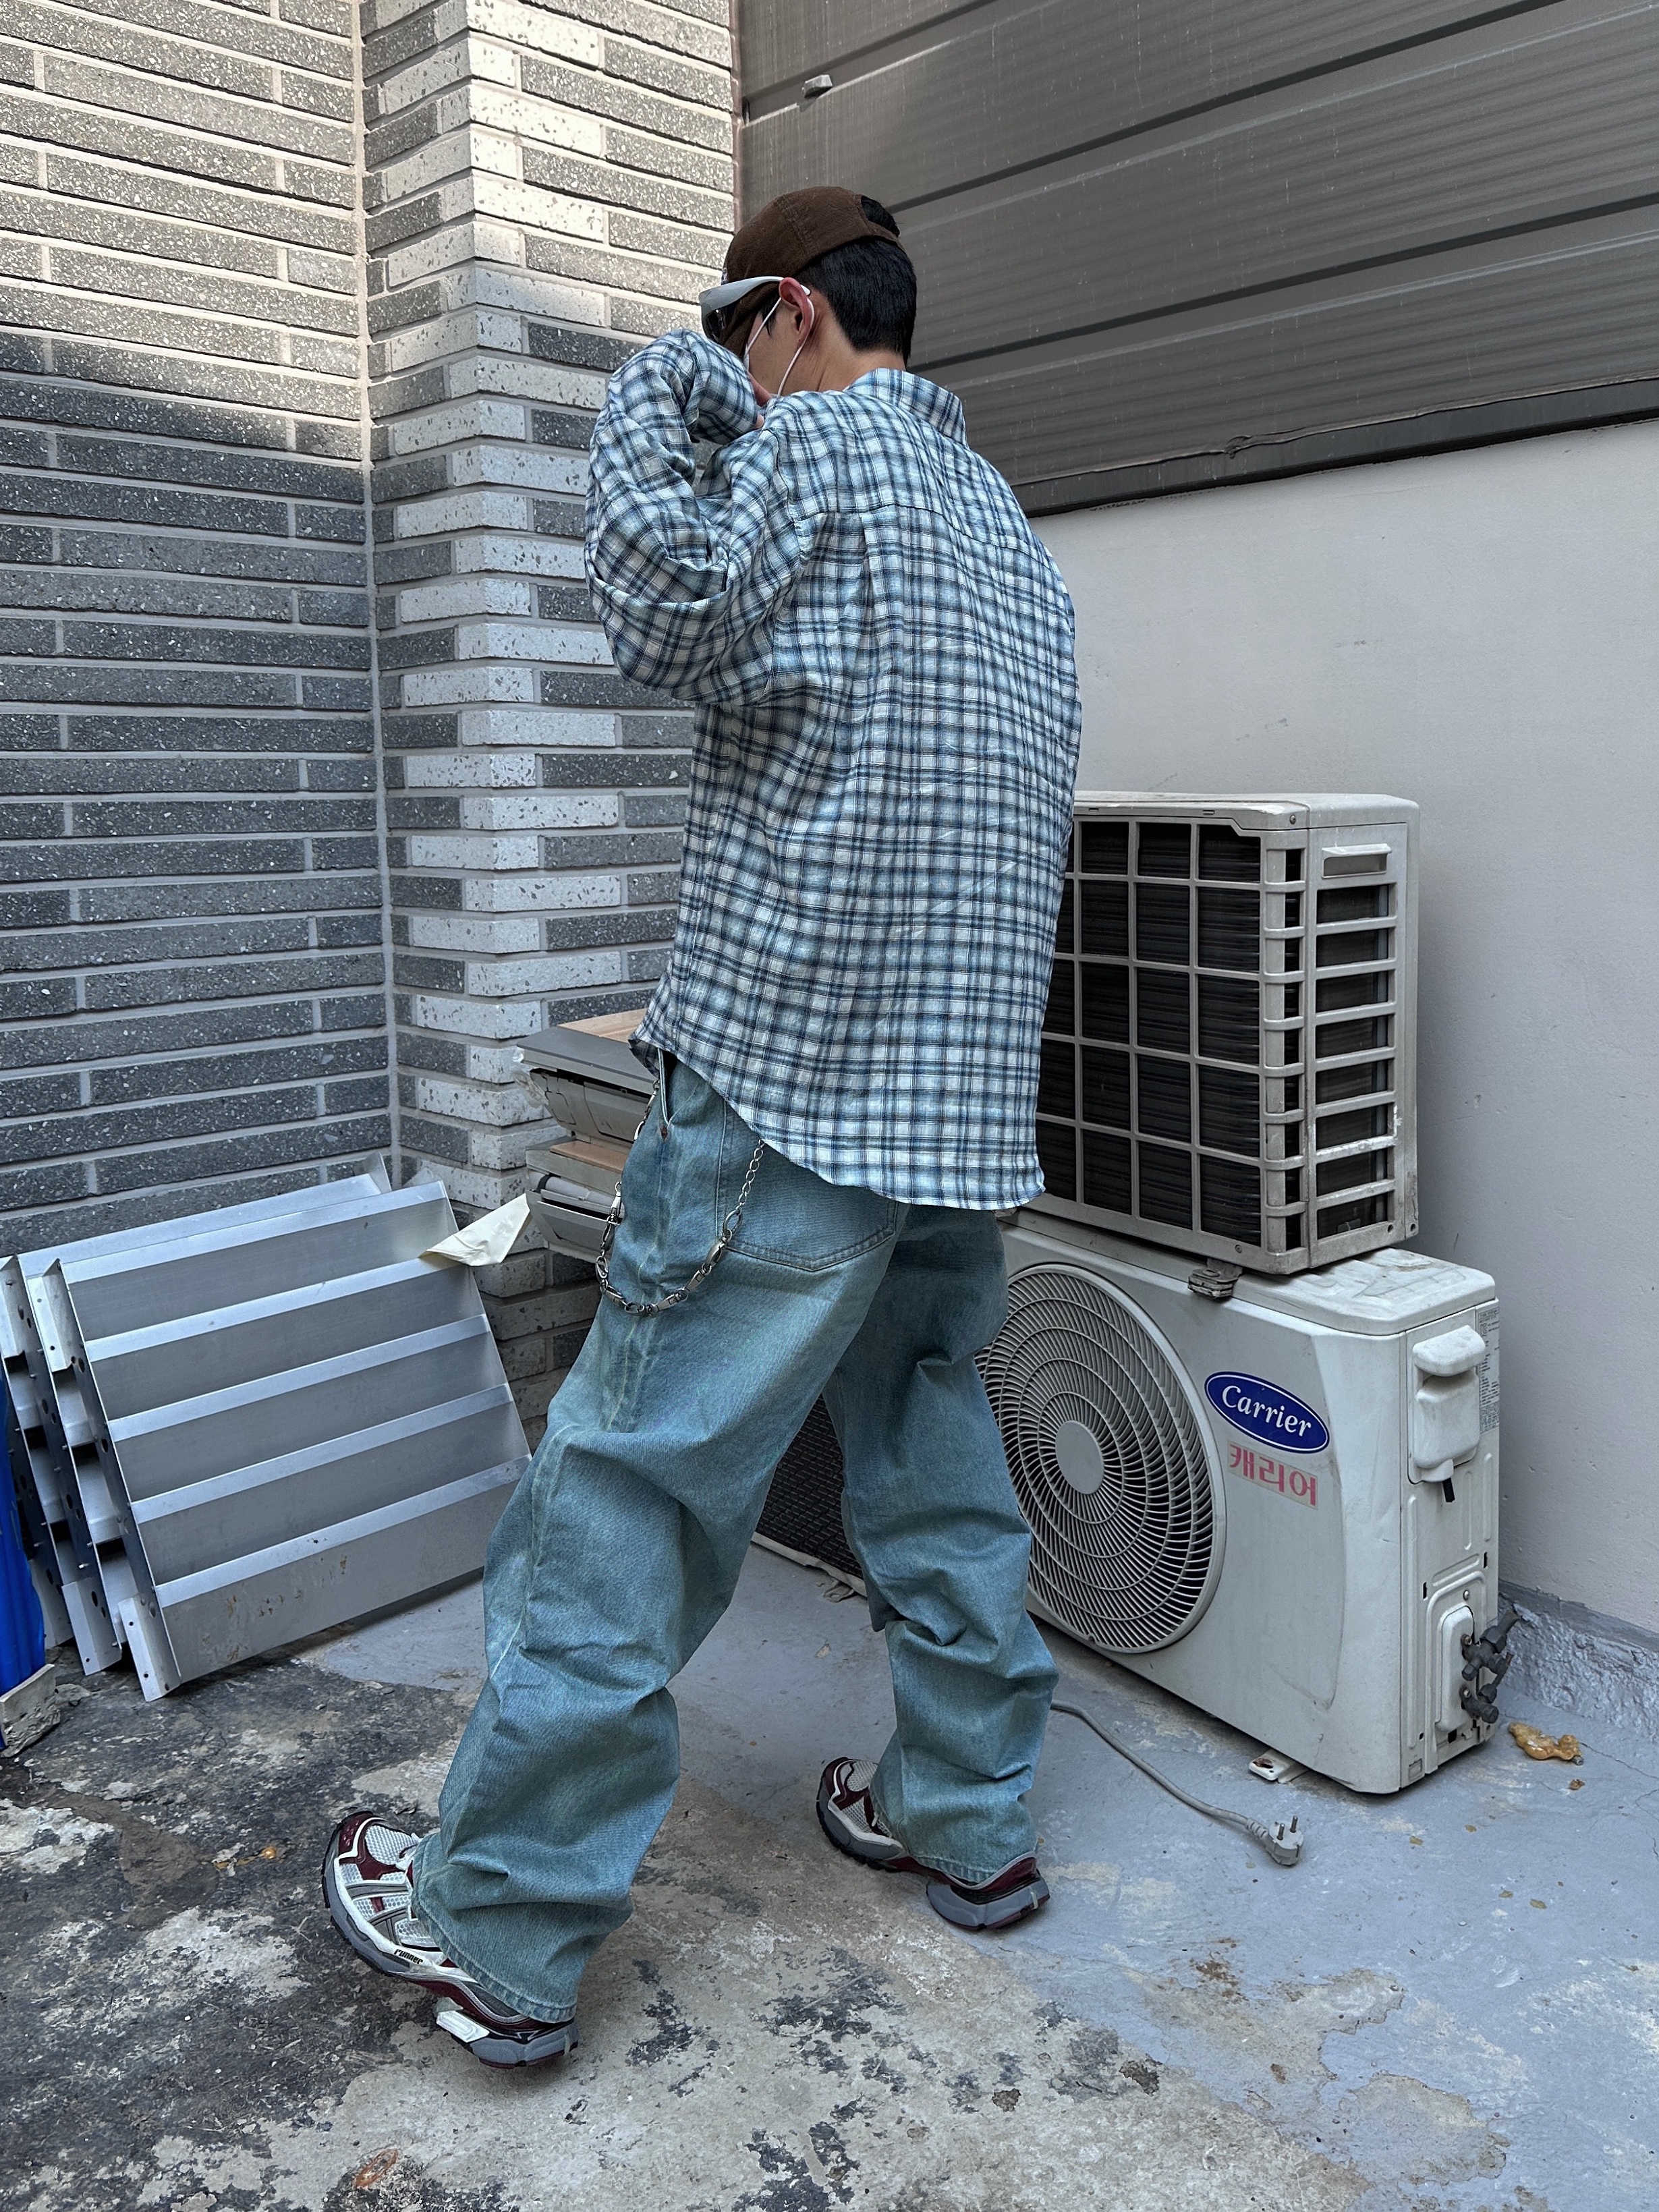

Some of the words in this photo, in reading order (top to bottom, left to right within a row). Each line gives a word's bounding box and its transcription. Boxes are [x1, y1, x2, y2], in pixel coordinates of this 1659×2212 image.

[1222, 1385, 1312, 1437] Carrier
[1229, 1444, 1316, 1506] 캐리어
[393, 1949, 424, 1964] runner
